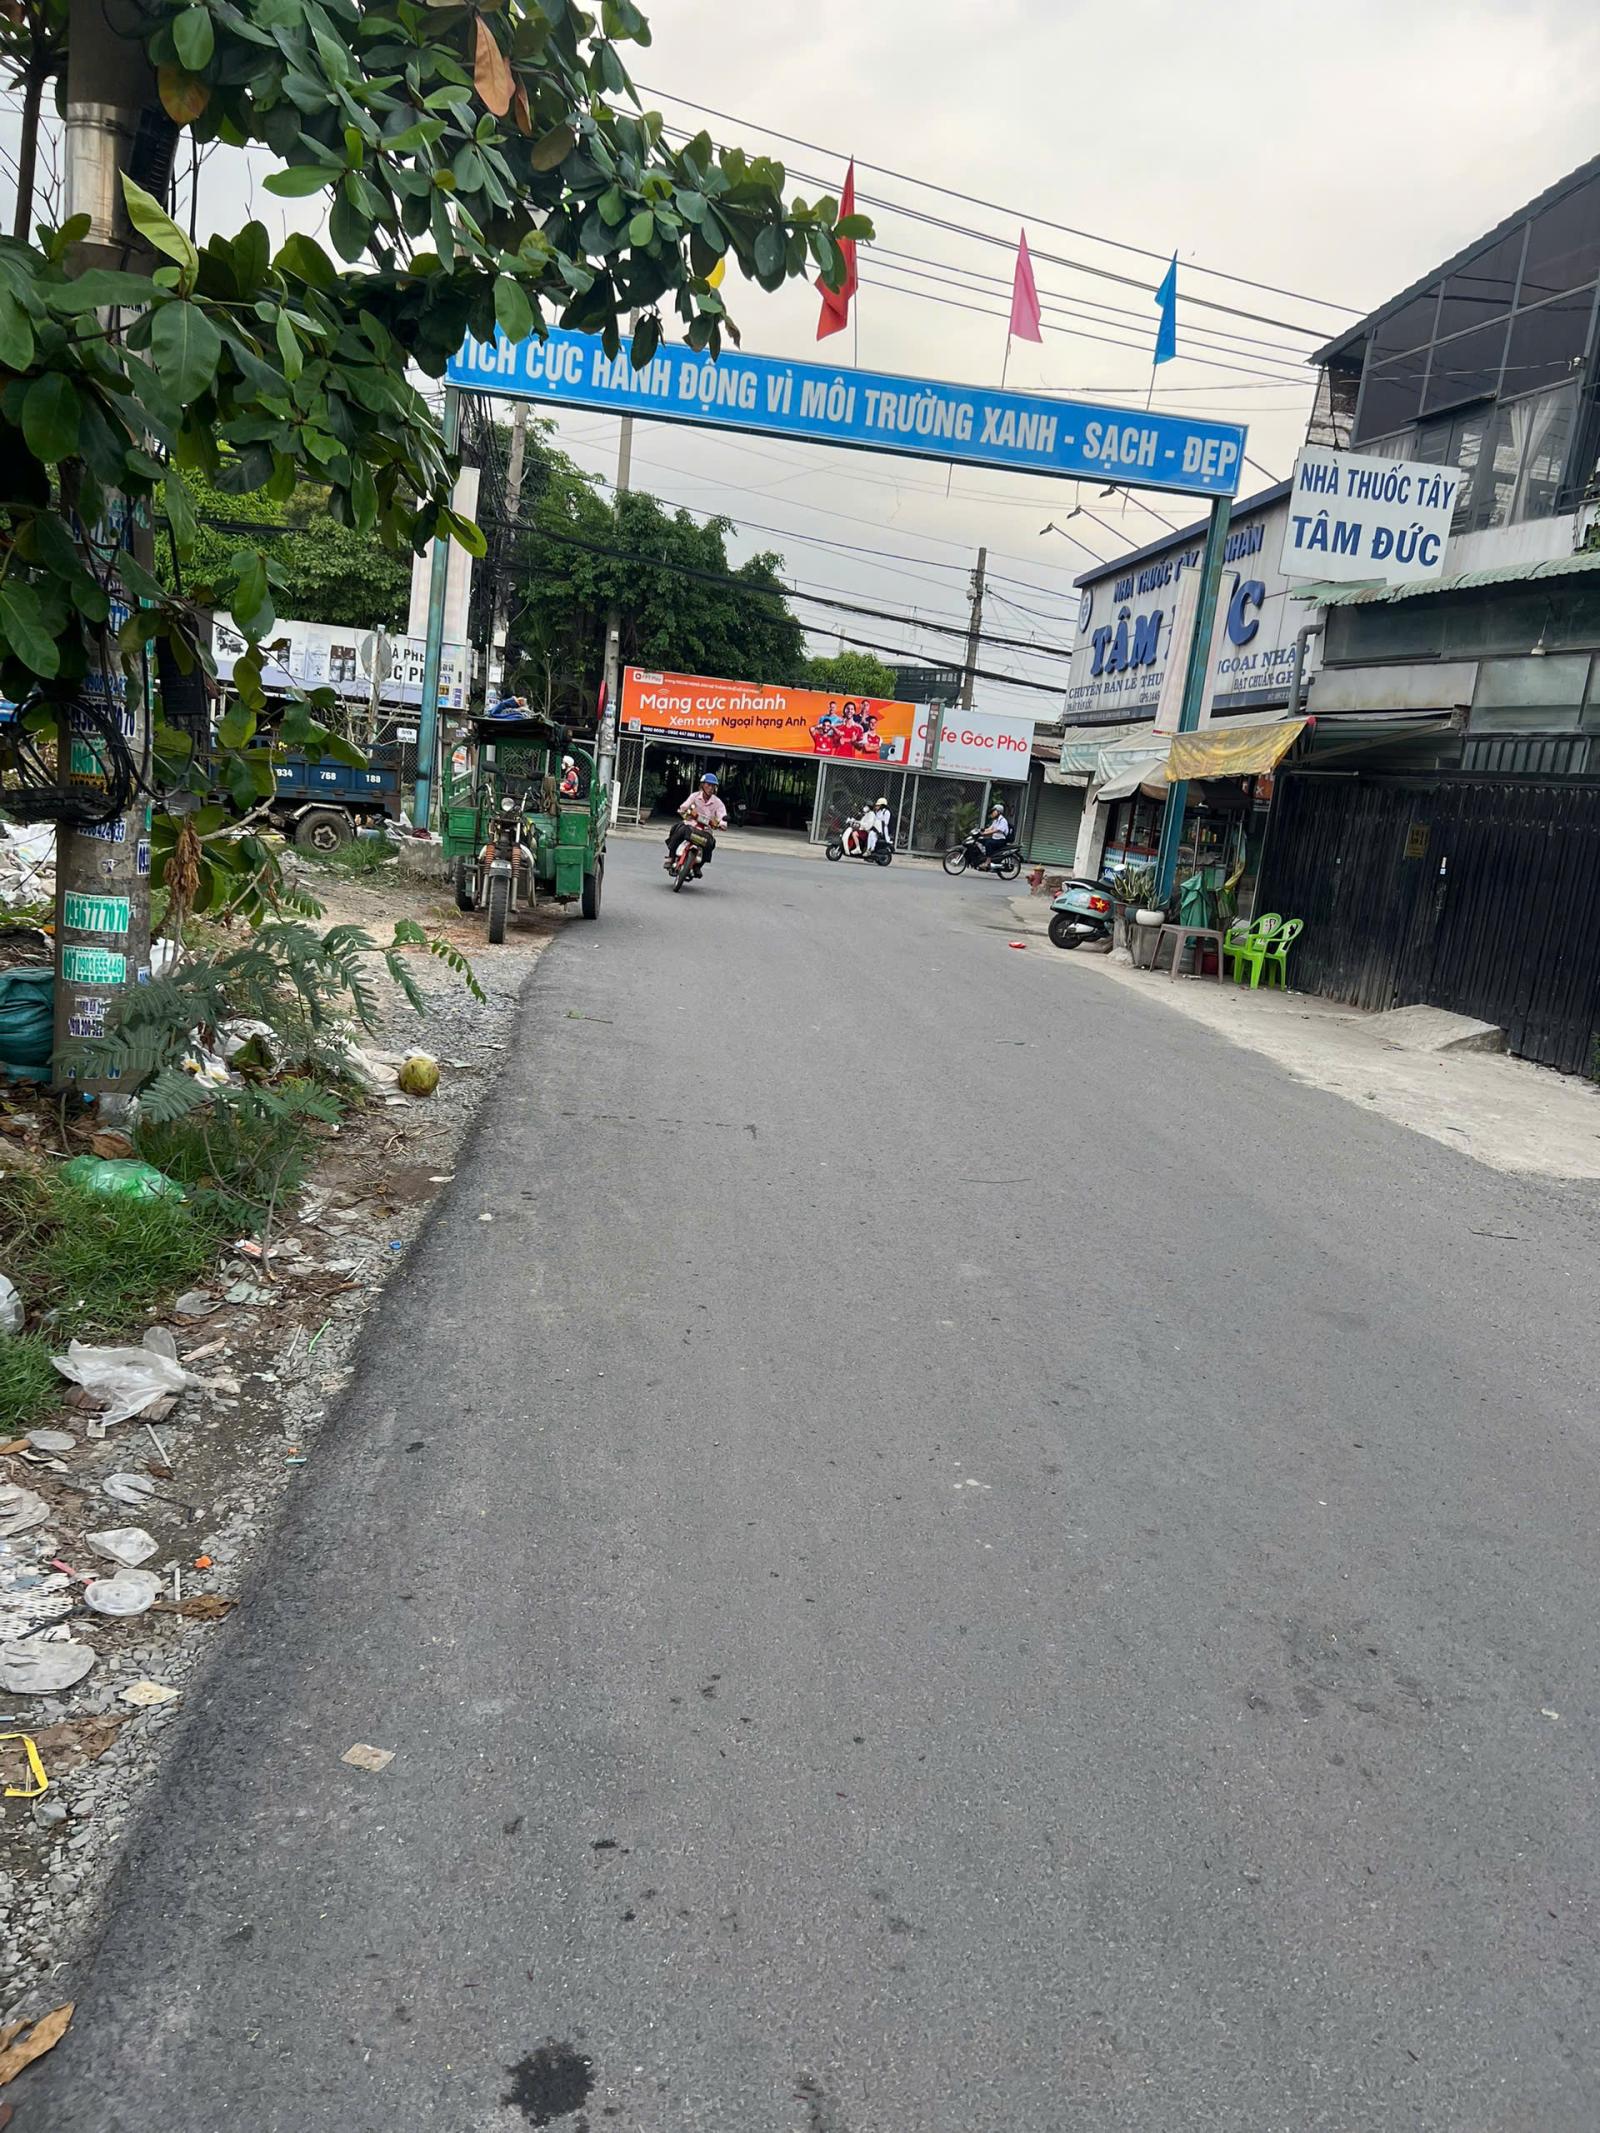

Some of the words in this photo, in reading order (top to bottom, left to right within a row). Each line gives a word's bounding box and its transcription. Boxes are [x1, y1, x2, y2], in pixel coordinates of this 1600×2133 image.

[525, 340, 584, 390] CỰC
[591, 344, 673, 397] HÀNH
[678, 357, 758, 412] ĐỘNG
[766, 368, 794, 415] VÌ
[799, 376, 854, 424] MÔI
[864, 388, 974, 440] TRƯỜNG
[979, 406, 1058, 453] XANH
[1082, 421, 1158, 469] SẠCH
[1181, 436, 1238, 483] ĐẸP
[1300, 459, 1340, 495] NHÀ
[1347, 464, 1411, 505] THUỐC
[1417, 473, 1456, 510] TÂY
[1292, 509, 1362, 556] TÂM
[1370, 522, 1441, 567] ĐỨC
[1136, 556, 1173, 595] THUỐC
[1090, 605, 1164, 676] TÂM
[639, 693, 692, 714] Mạng
[696, 695, 726, 714] cực
[729, 693, 787, 711] nhanh
[1068, 682, 1103, 699] CHUYÊN
[1103, 675, 1123, 694] BÁN
[669, 715, 695, 726] Xem
[697, 716, 719, 728] trọn
[721, 716, 754, 729] Ngoại
[755, 716, 783, 729] hạng
[785, 716, 807, 726] Anh
[918, 724, 957, 743] Cfe
[961, 730, 994, 748] Góc
